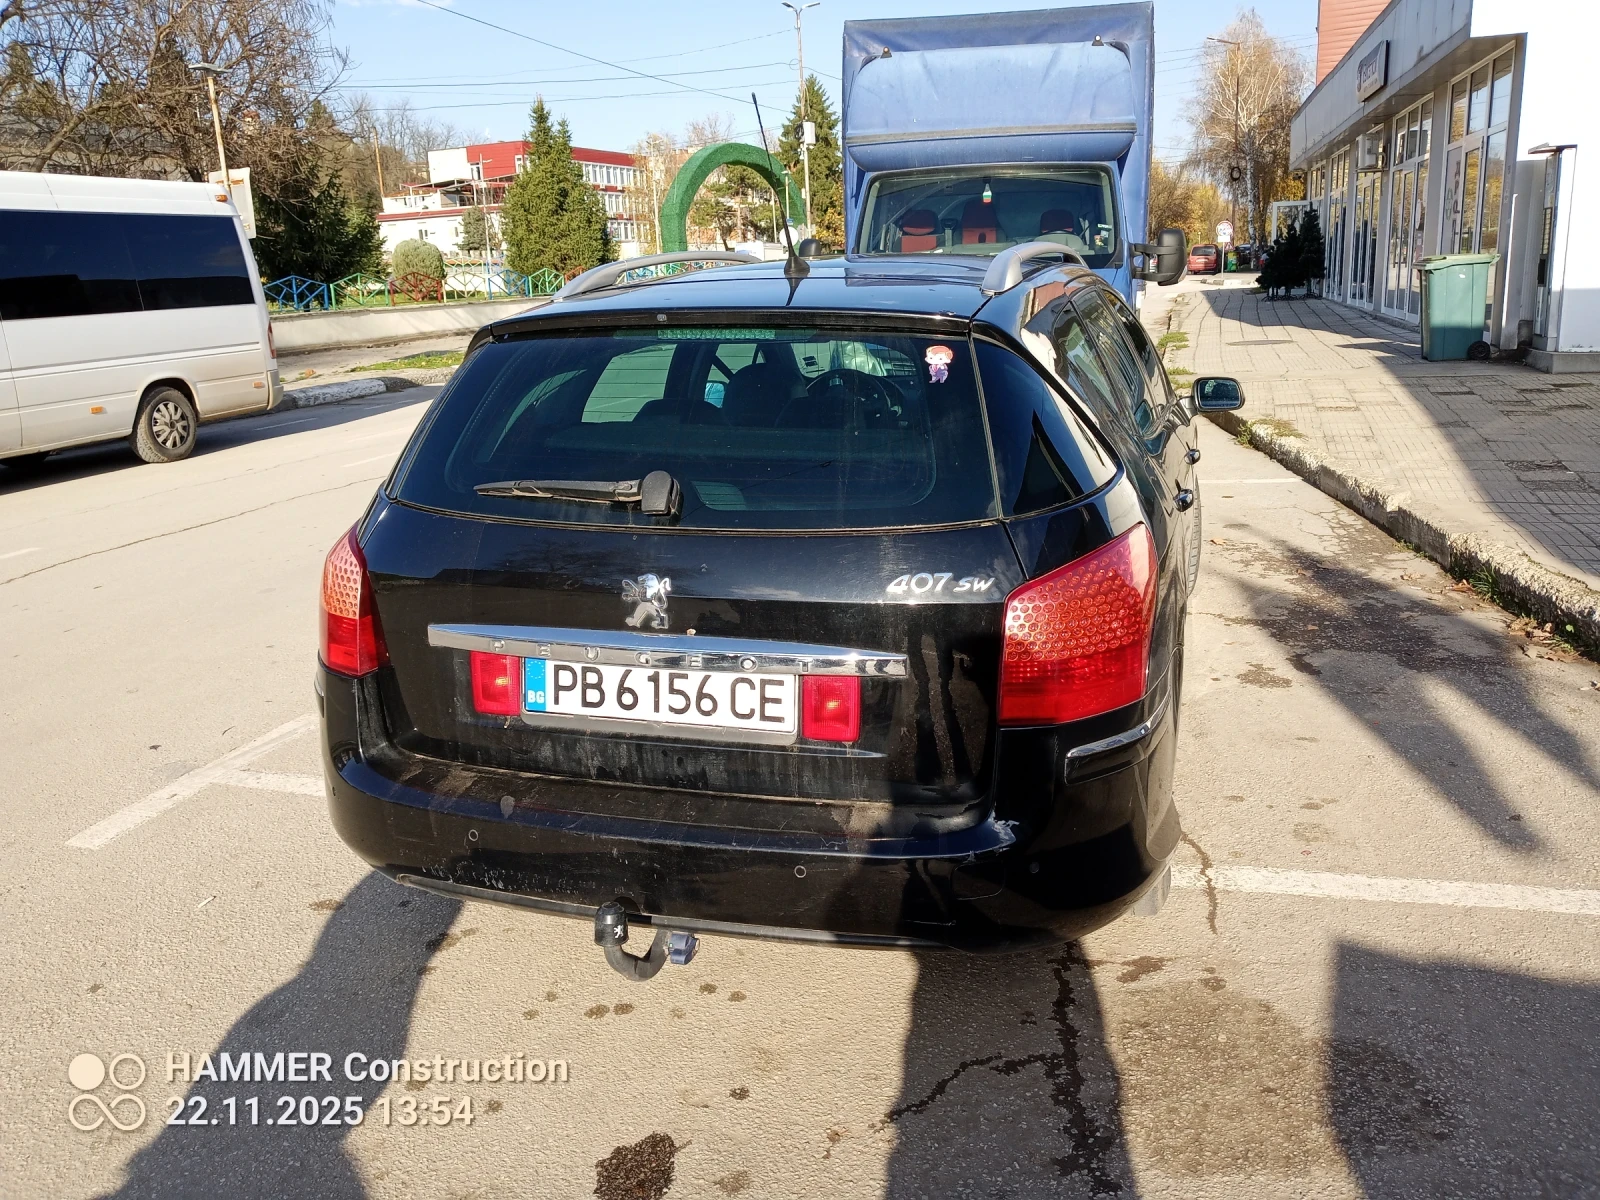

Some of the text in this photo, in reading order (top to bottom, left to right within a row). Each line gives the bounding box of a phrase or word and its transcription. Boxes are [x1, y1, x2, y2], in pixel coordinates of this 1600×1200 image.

[886, 572, 953, 594] 407
[490, 639, 814, 673] PEUGEOT
[527, 689, 545, 704] BG
[553, 664, 785, 724] PB 6156 CE
